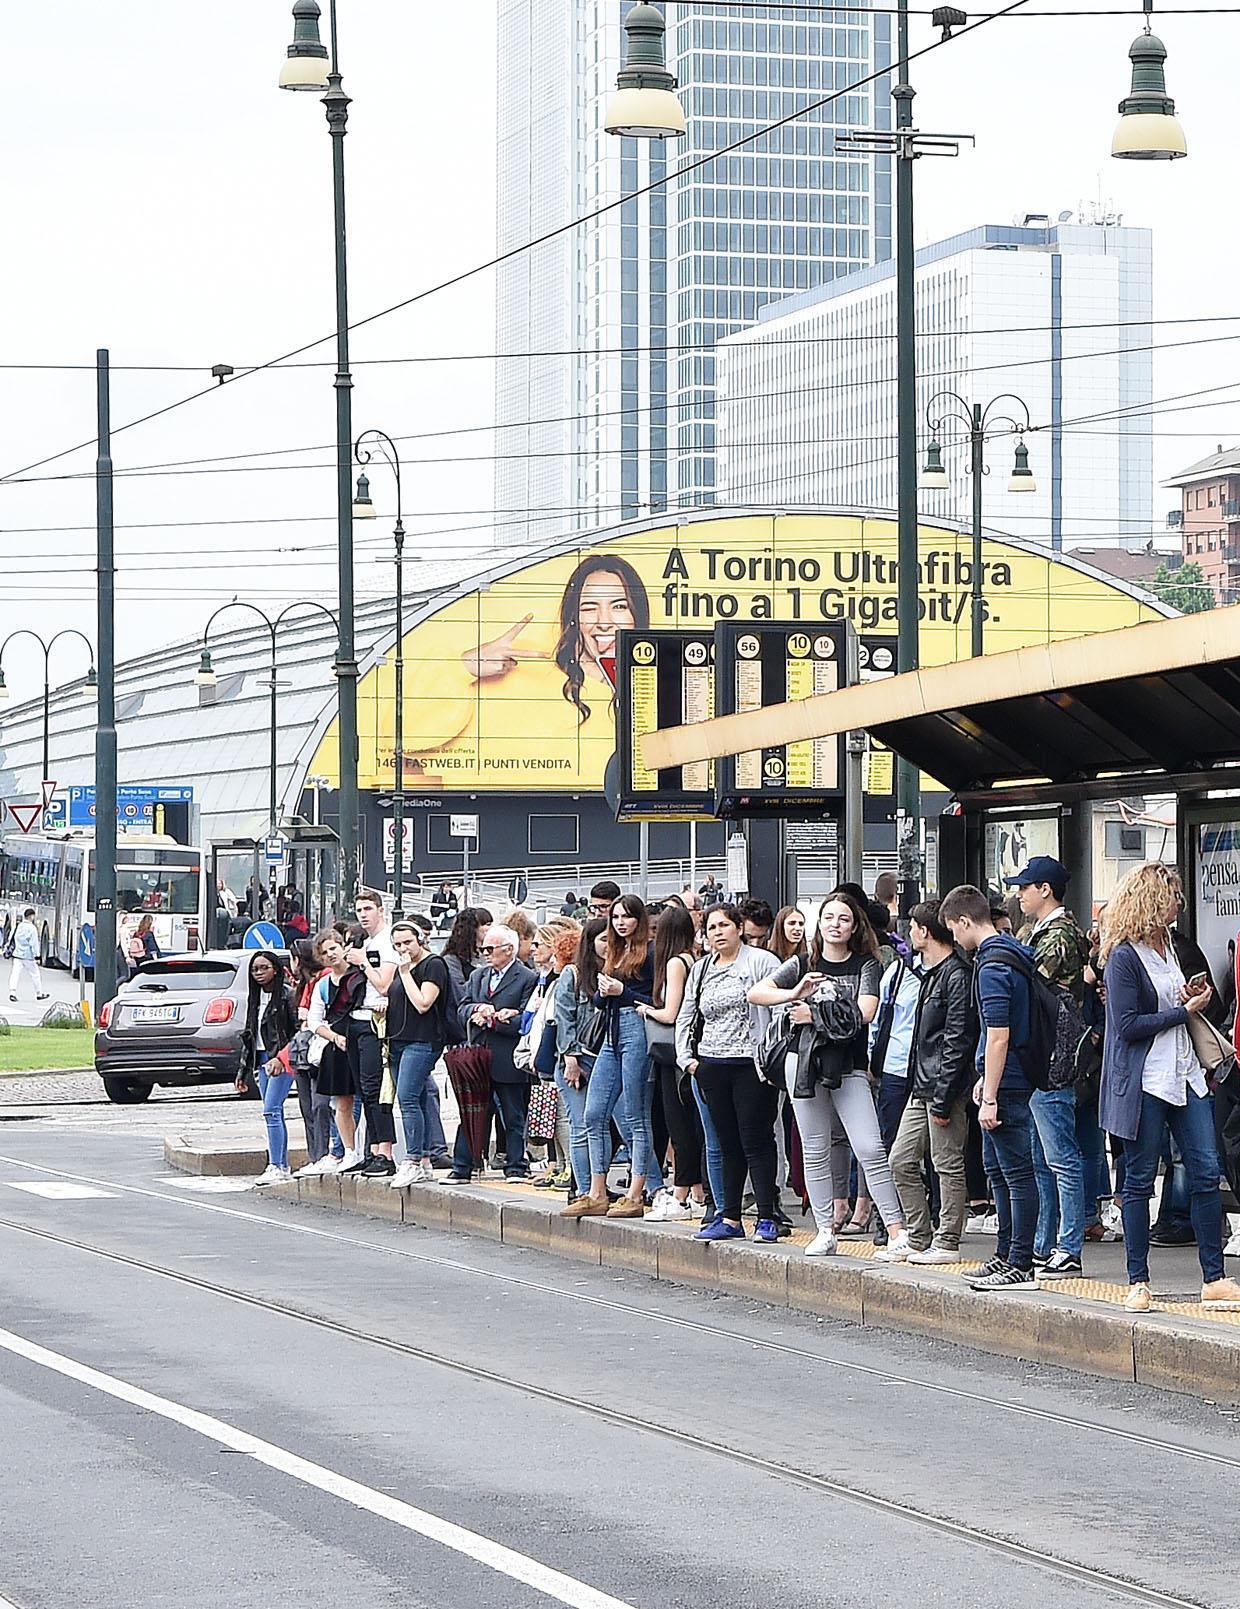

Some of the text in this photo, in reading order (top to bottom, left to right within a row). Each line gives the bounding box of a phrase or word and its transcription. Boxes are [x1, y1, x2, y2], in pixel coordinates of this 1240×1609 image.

[662, 547, 1011, 585] A Torino Ultrfibra
[662, 583, 739, 617] fino
[750, 594, 772, 618] a
[787, 587, 801, 618] 1
[741, 642, 756, 651] 56
[791, 637, 808, 648] 10
[636, 647, 652, 657] 10
[688, 649, 703, 658] 49
[406, 759, 476, 768] FASTWEB.IT
[484, 759, 519, 769] PUNTI
[523, 759, 572, 769] VENDITA
[767, 762, 782, 774] 10
[402, 799, 442, 807] ediaOne
[1201, 862, 1238, 900] pensa
